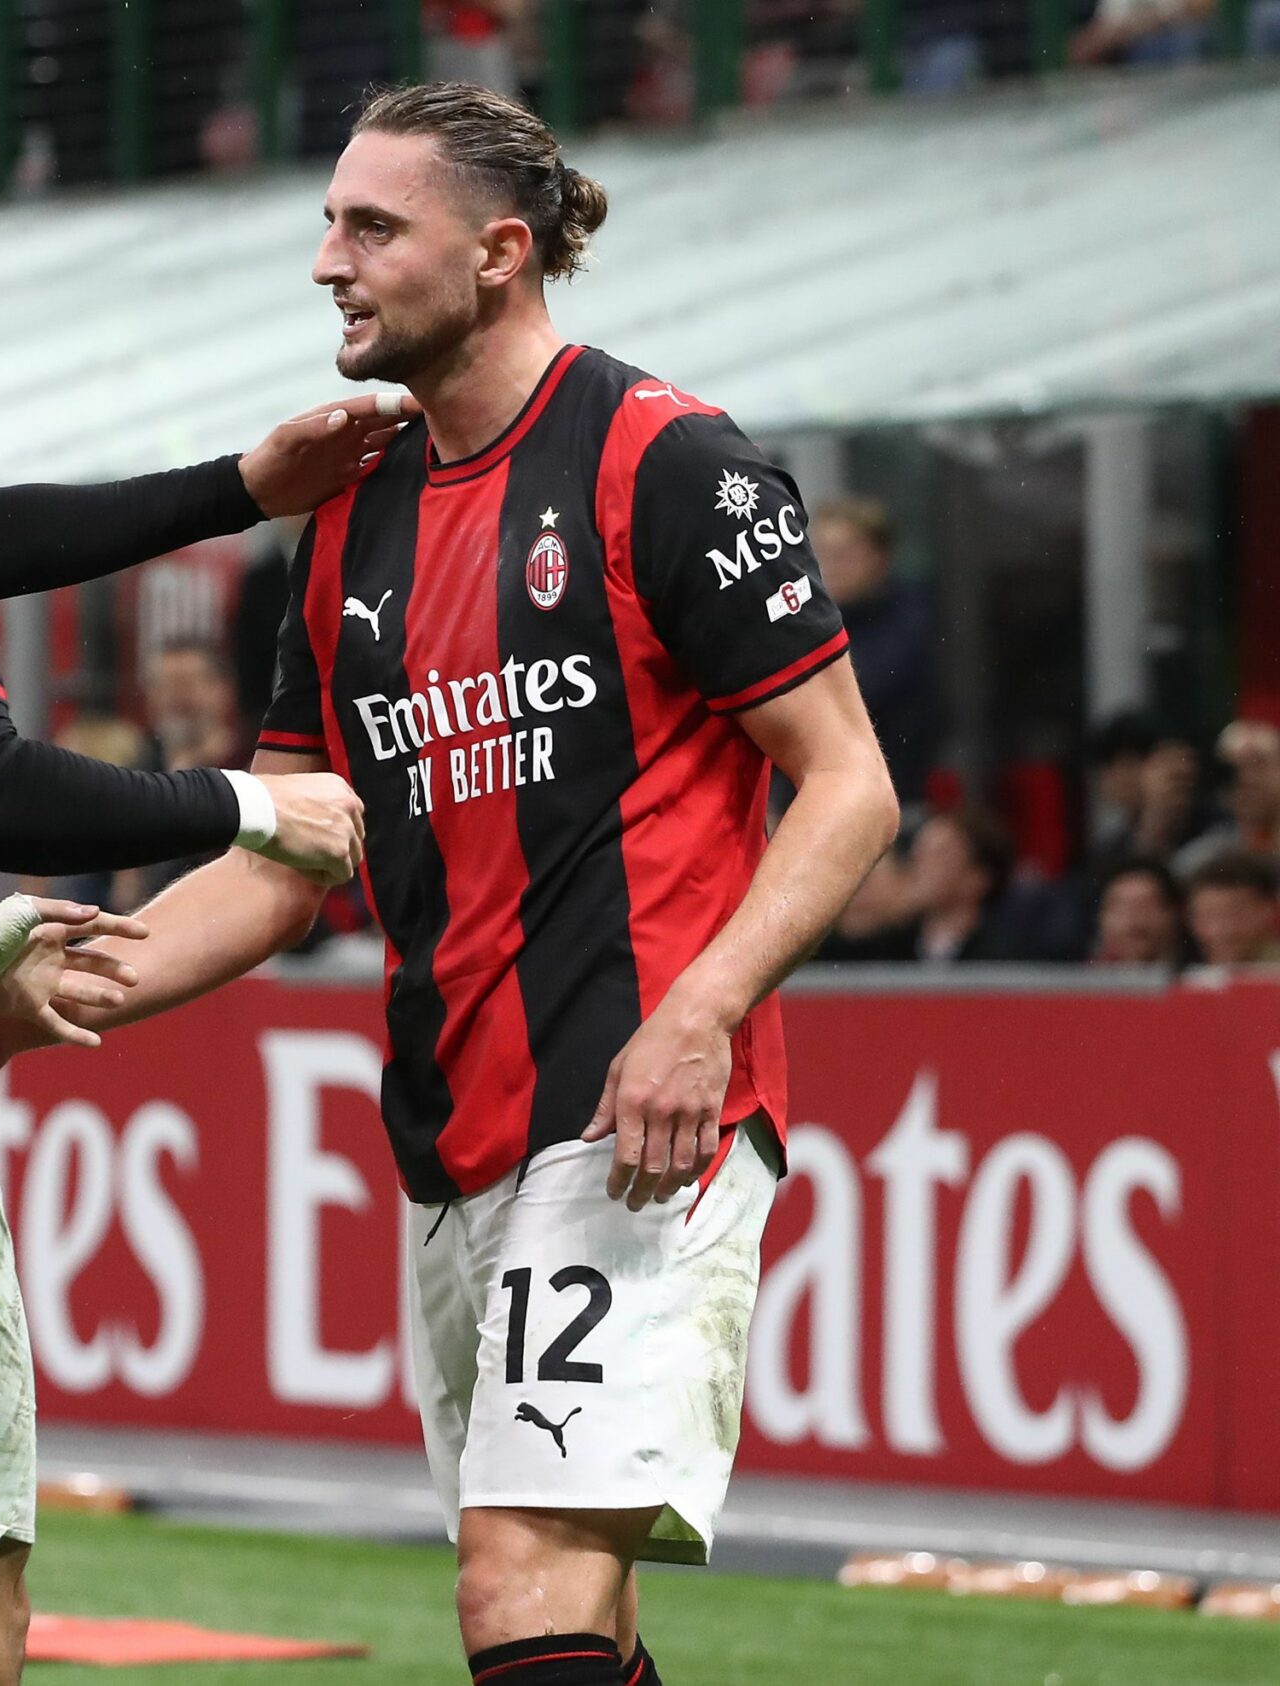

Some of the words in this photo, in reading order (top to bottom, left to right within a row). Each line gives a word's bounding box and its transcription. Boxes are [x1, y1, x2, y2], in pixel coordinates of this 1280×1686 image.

[537, 537, 558, 550] ACM
[705, 504, 804, 590] MSC
[537, 591, 557, 602] 1899
[781, 584, 800, 612] 6
[352, 653, 597, 761] Emirates
[449, 726, 556, 804] BETTER
[501, 1265, 612, 1384] 12
